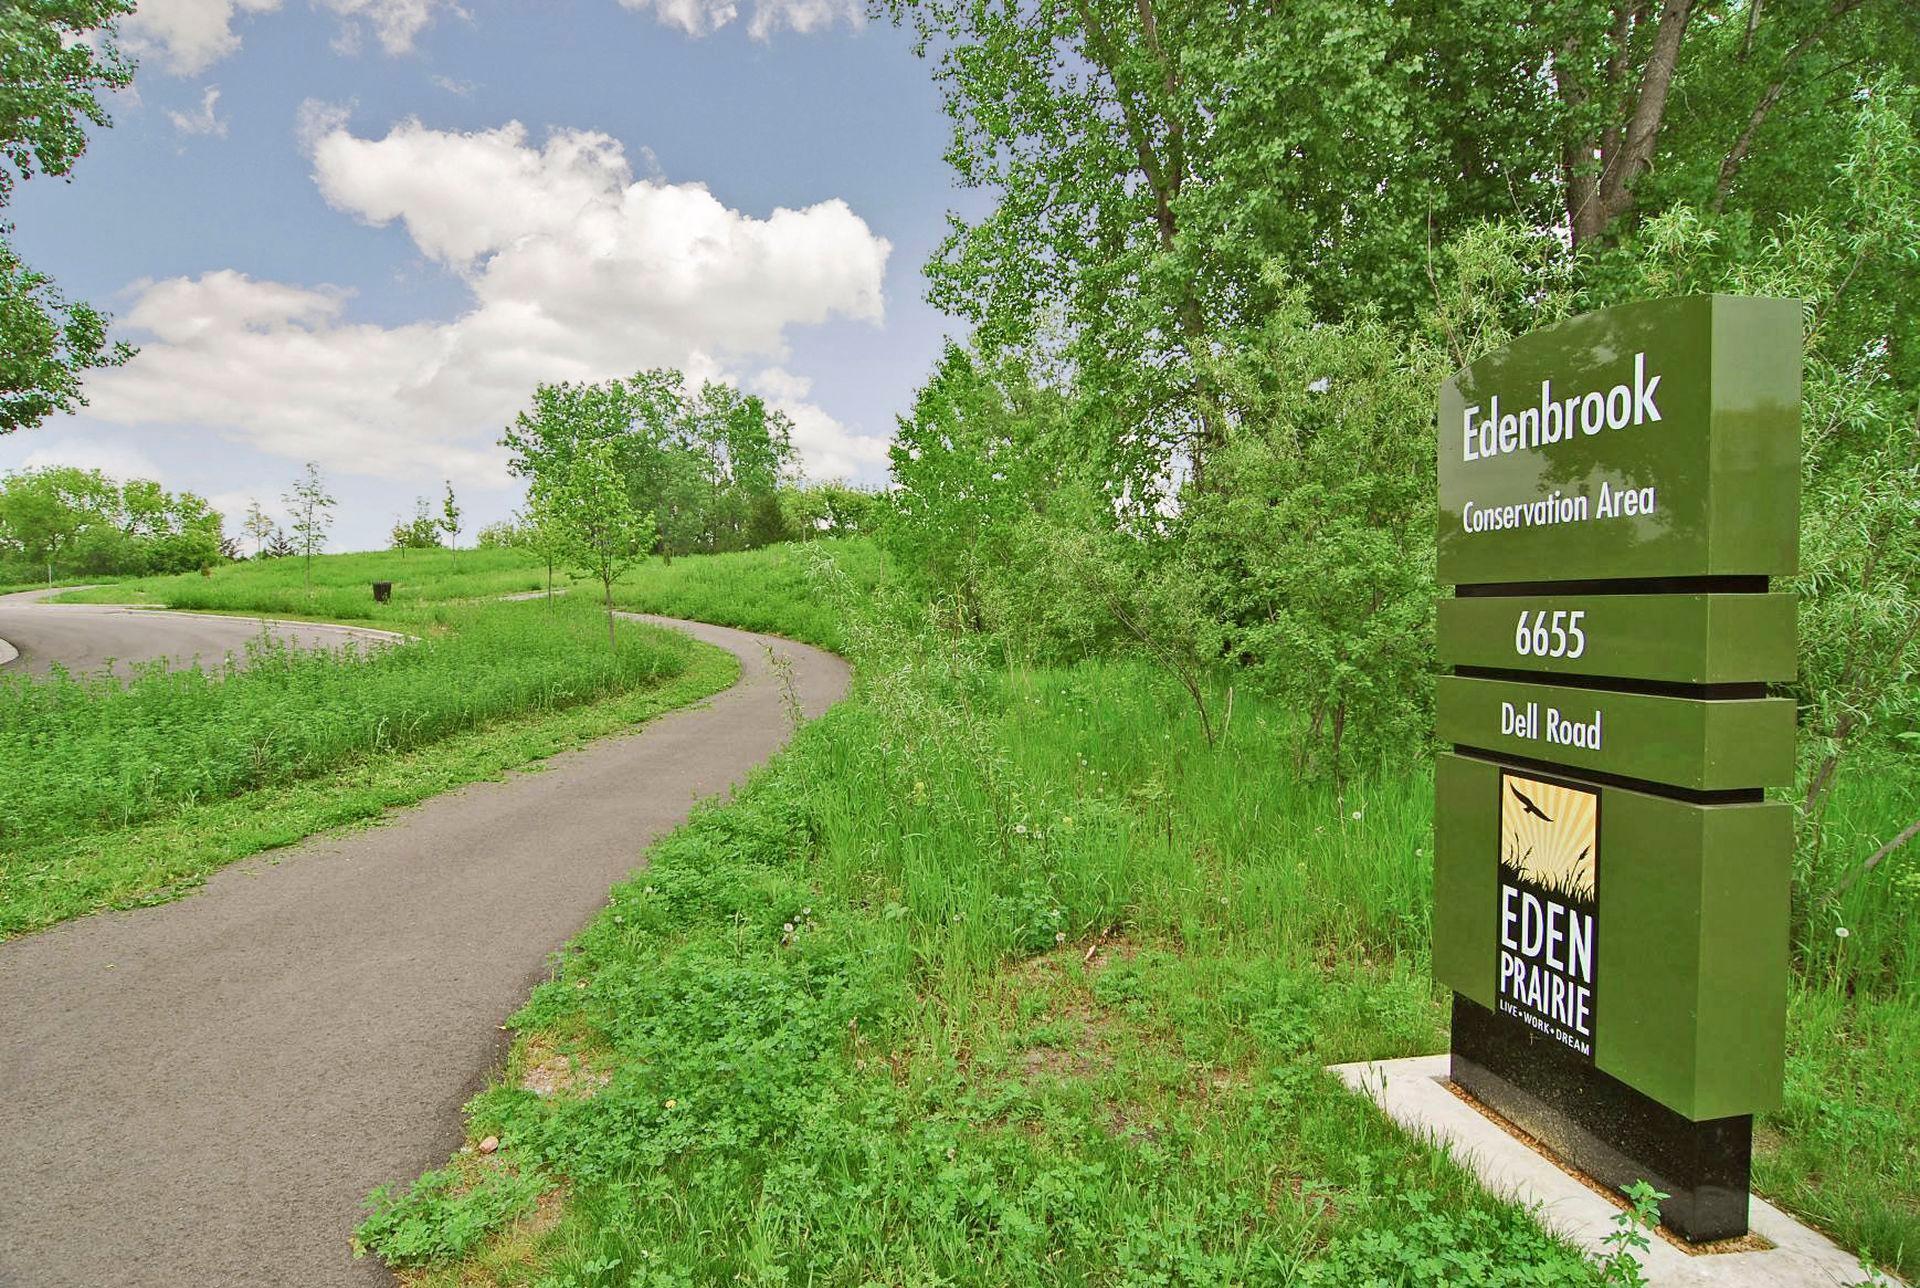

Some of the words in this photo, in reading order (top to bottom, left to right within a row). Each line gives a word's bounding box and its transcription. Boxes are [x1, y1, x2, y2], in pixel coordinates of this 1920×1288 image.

[1463, 352, 1662, 462] Edenbrook
[1463, 491, 1588, 533] Conservation
[1596, 482, 1655, 519] Area
[1515, 610, 1586, 659] 6655
[1501, 702, 1538, 740] Dell
[1546, 708, 1602, 751] Road
[1501, 884, 1592, 983] EDEN
[1500, 955, 1590, 1036] PRAIRIE
